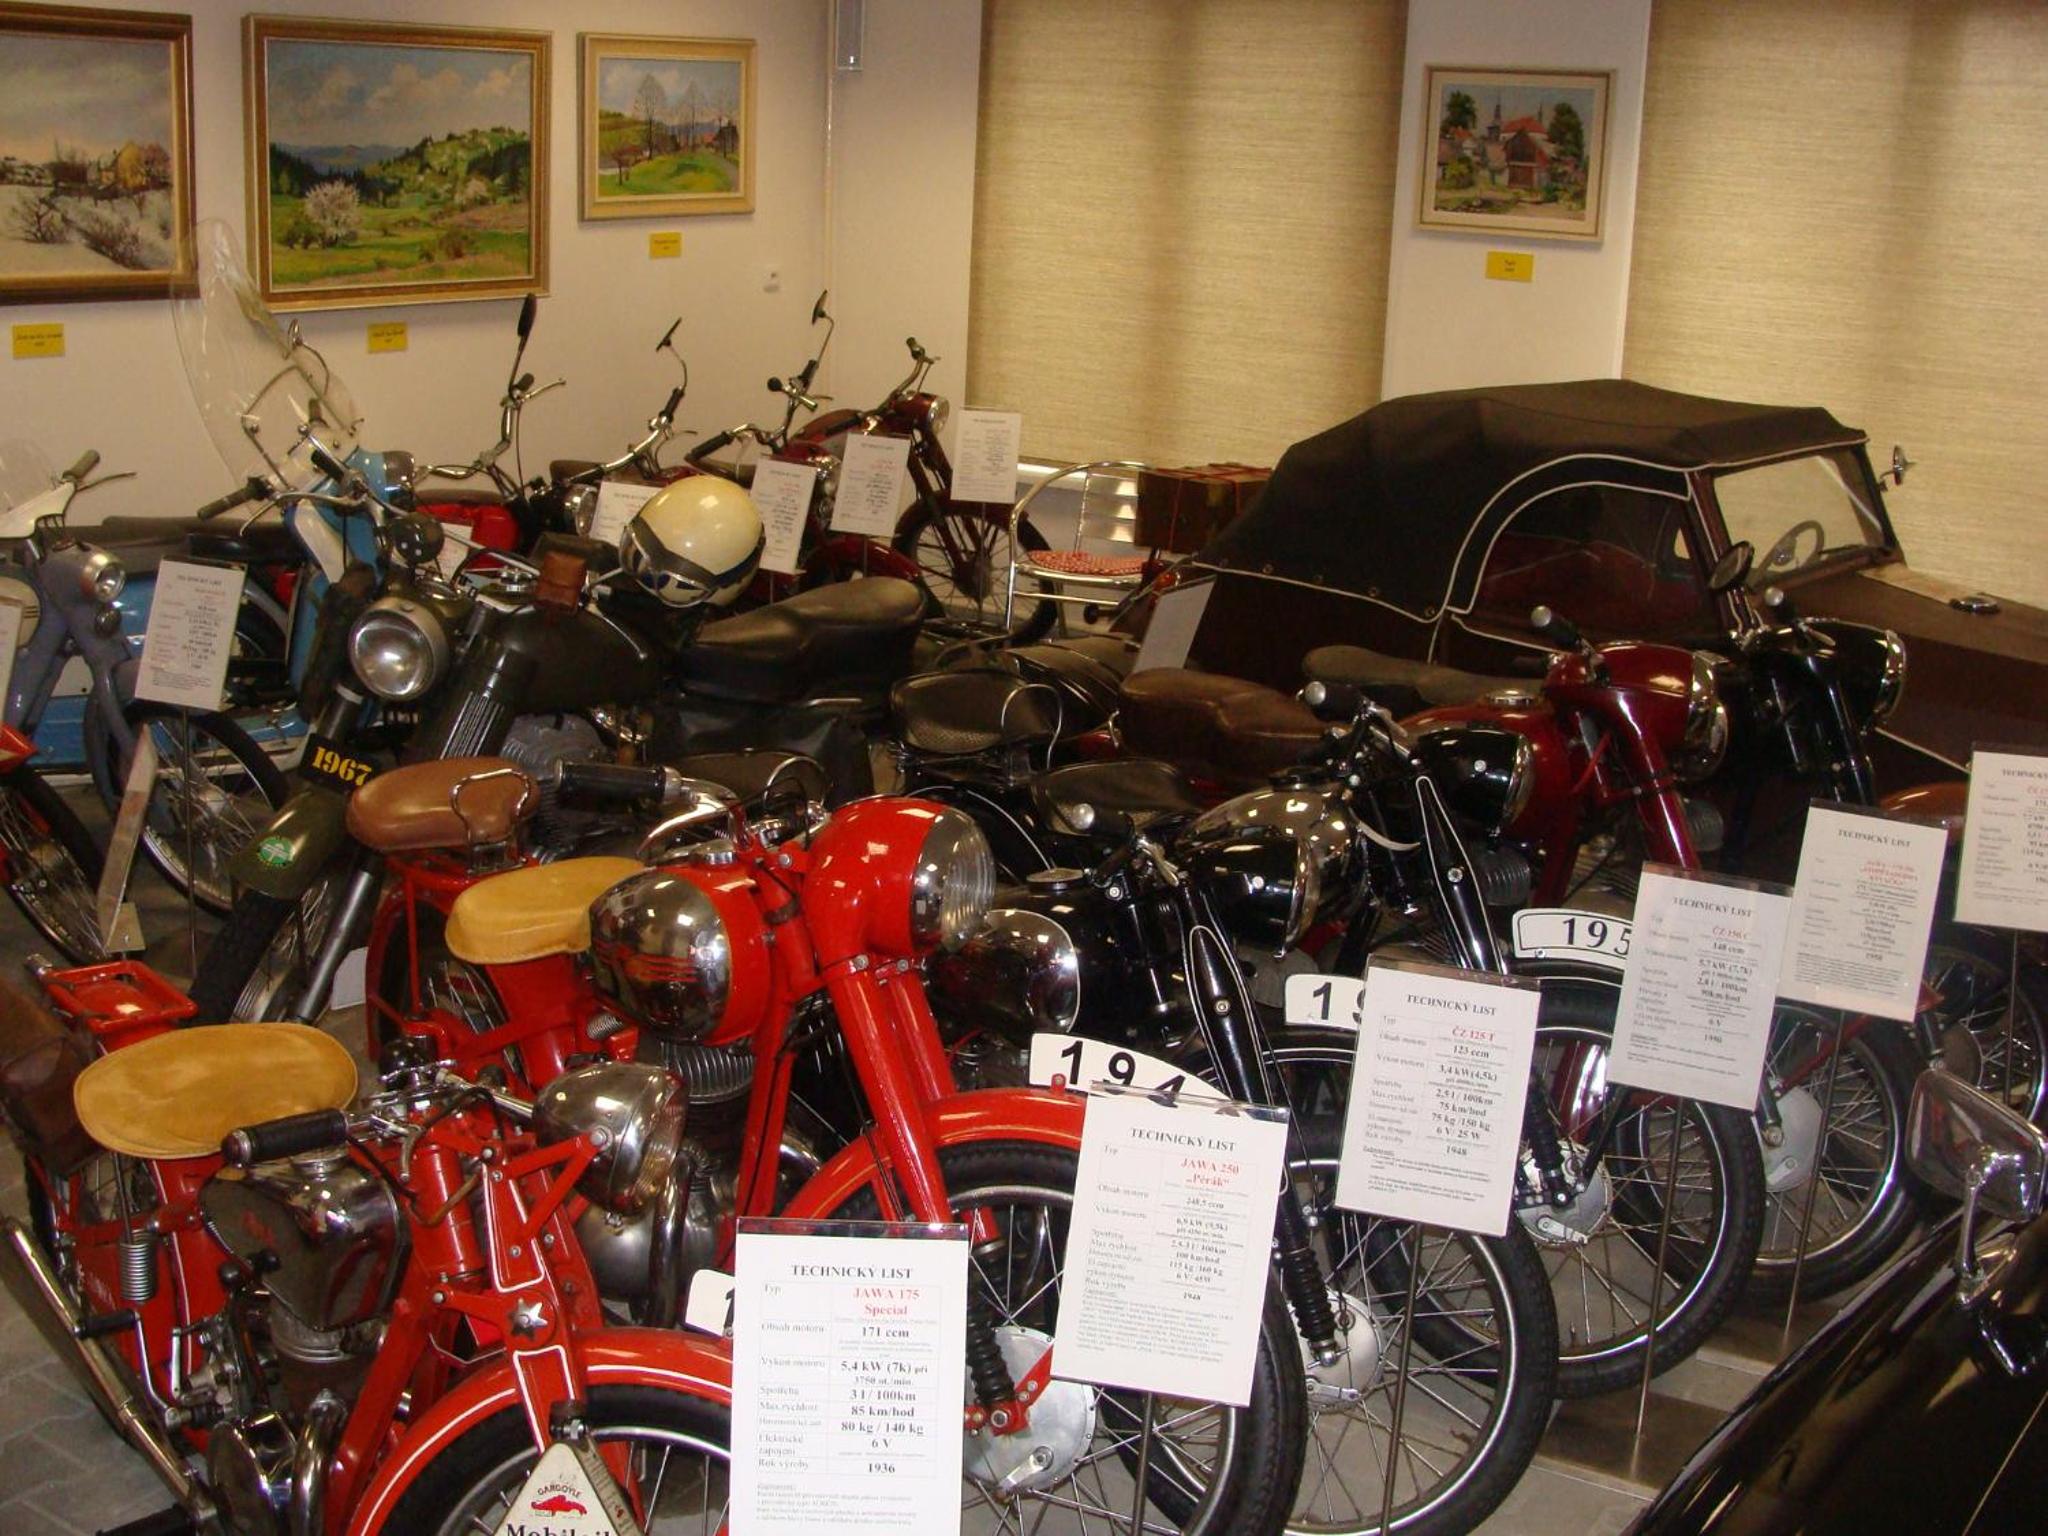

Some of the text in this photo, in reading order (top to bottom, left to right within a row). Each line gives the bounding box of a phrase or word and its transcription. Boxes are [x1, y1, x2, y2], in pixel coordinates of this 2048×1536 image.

[312, 746, 373, 786] 1967
[1562, 917, 1632, 956] 195
[1473, 1004, 1497, 1016] LIST
[1208, 1139, 1236, 1152] LIST
[1180, 1158, 1216, 1172] JAWA
[791, 1264, 912, 1279] TECHNICKÝ LIST
[853, 1287, 895, 1300] JAWA
[900, 1289, 920, 1300] 175
[864, 1304, 908, 1317] Special
[861, 1327, 910, 1338] 171 ccm
[862, 1361, 882, 1372] kW
[886, 1361, 912, 1374] (7k)
[850, 1389, 858, 1400] 3
[877, 1390, 916, 1401] 100km
[851, 1405, 915, 1417] 85 km/hod
[841, 1421, 856, 1431] 80
[859, 1422, 874, 1434] kg
[886, 1423, 906, 1433] 140
[909, 1423, 924, 1436] kg
[871, 1438, 893, 1448] 6 V
[868, 1462, 896, 1474] 1936
